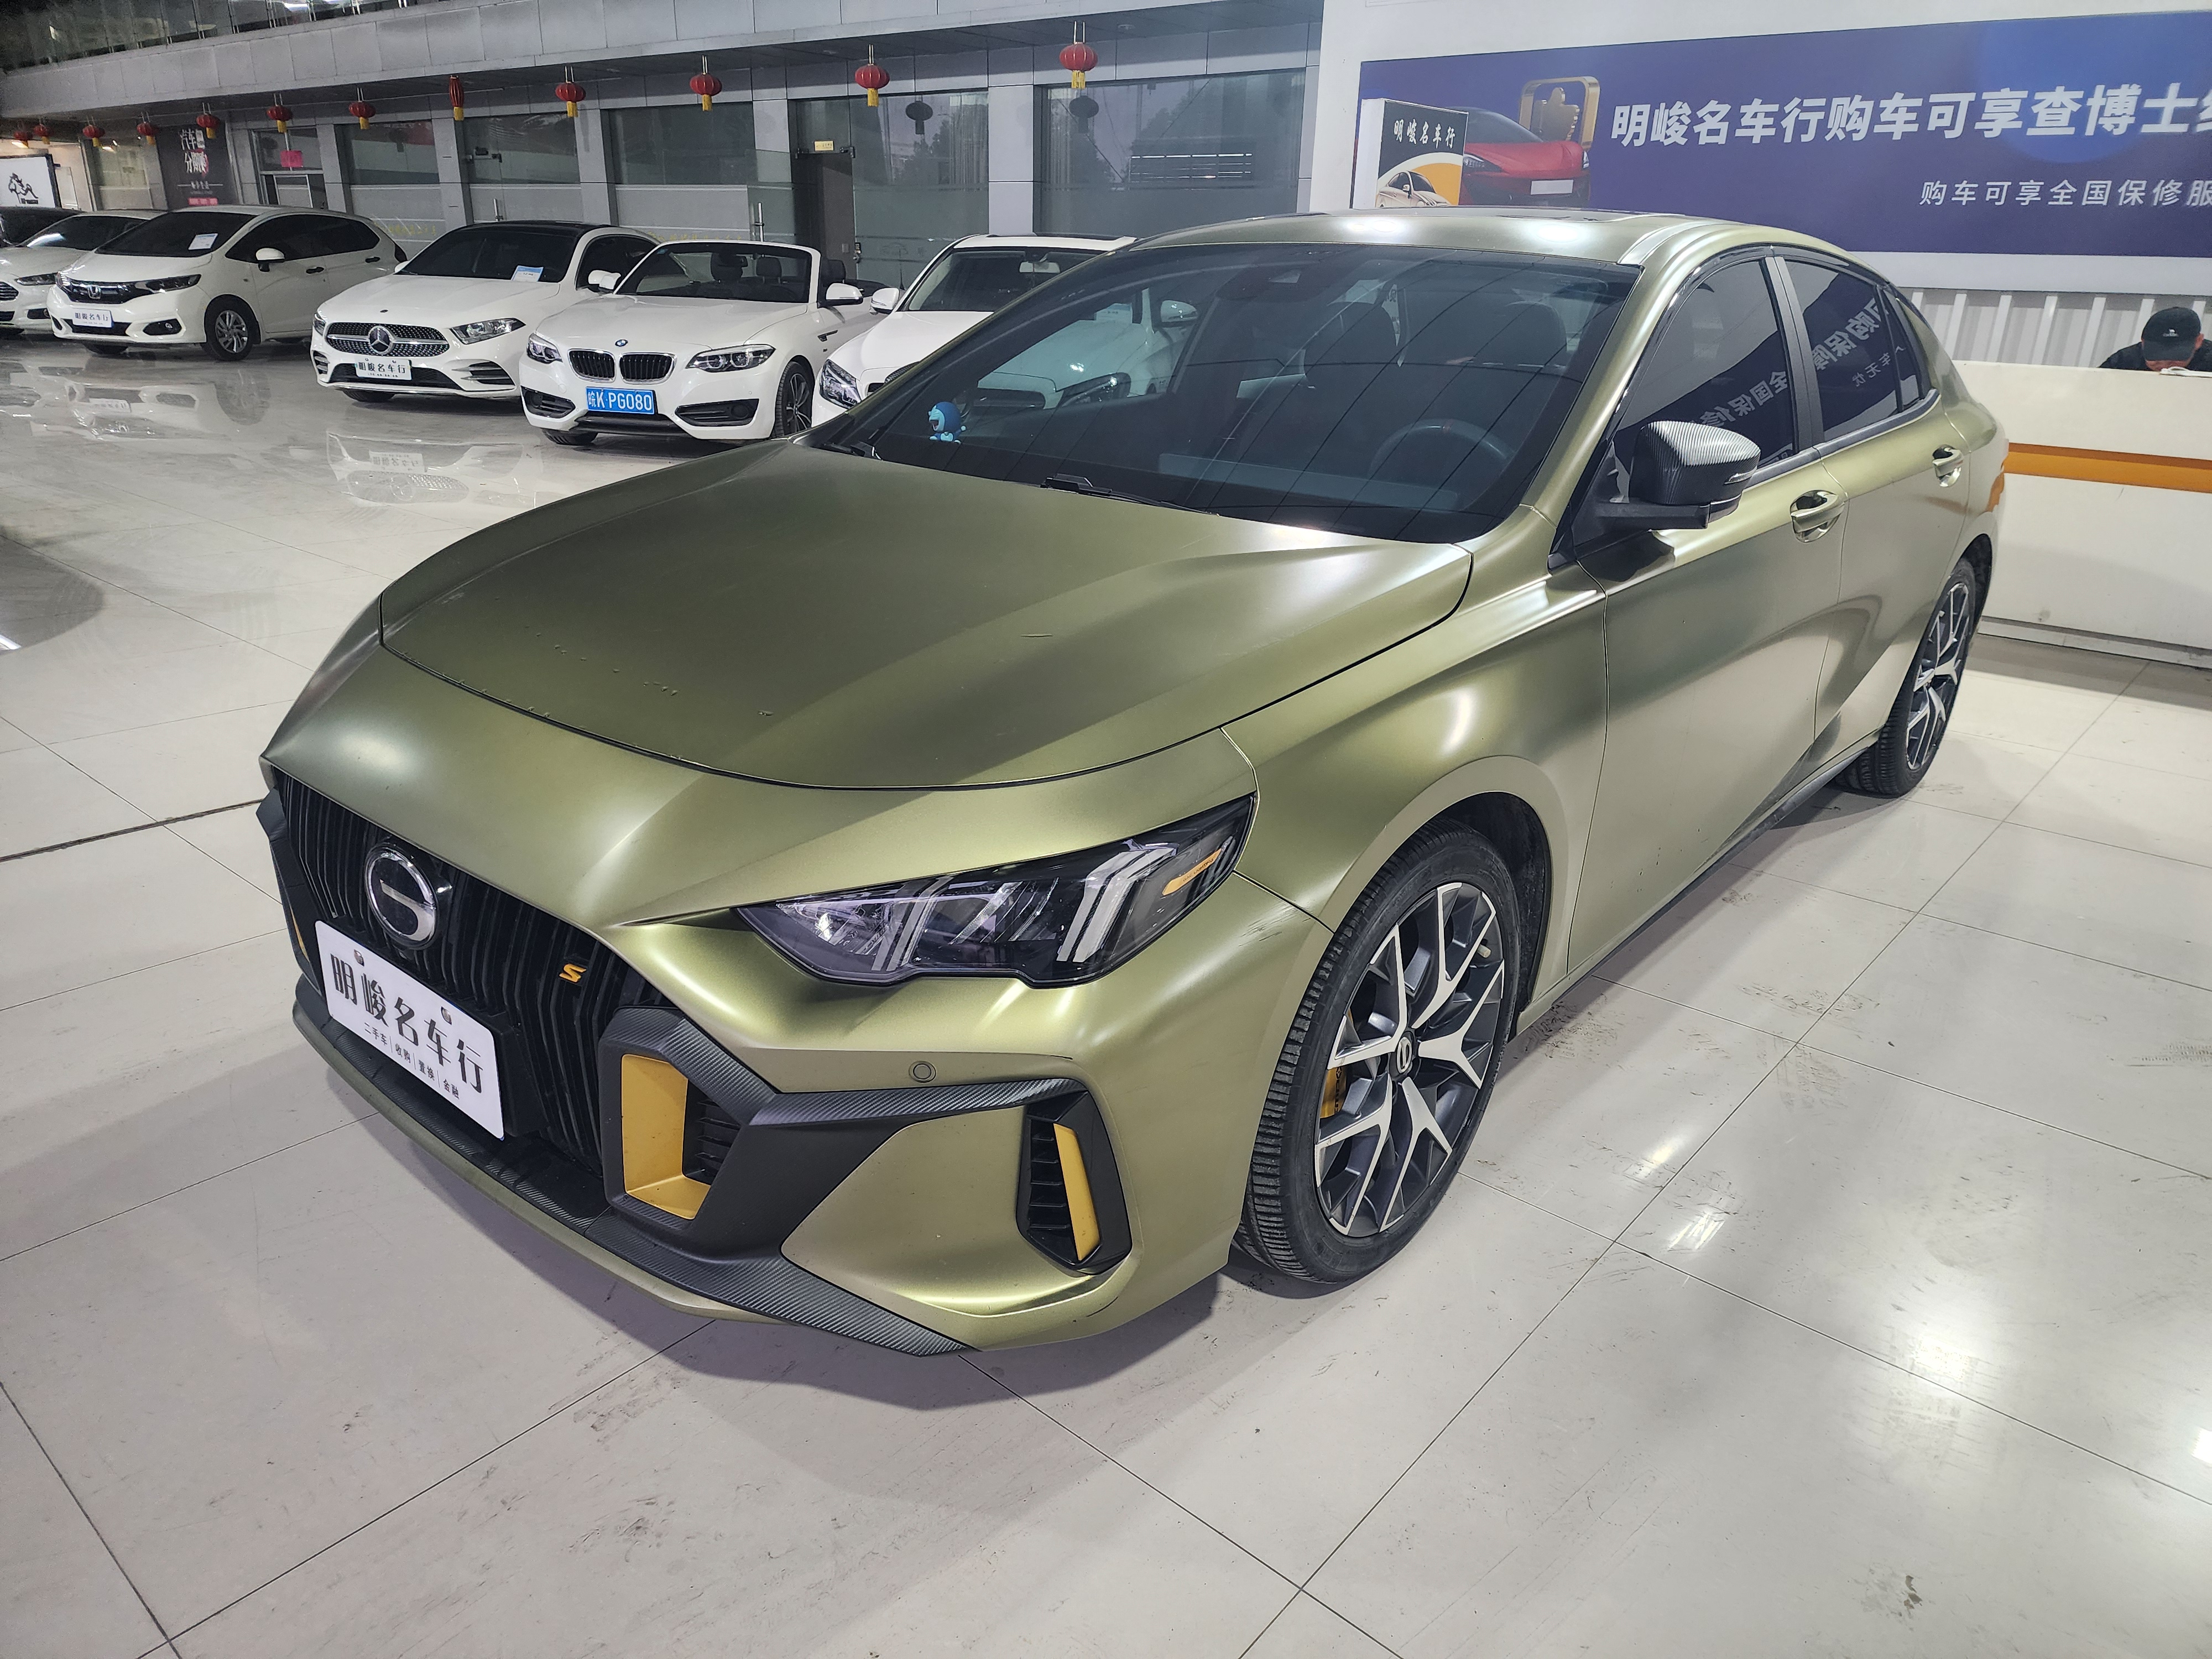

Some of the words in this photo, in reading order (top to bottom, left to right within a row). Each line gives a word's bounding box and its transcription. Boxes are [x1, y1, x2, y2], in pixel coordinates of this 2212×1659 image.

[1394, 118, 1455, 149] 明峻名车行
[1919, 179, 2212, 206] 购车可享全国保修服
[358, 362, 406, 373] 明峻名车行
[330, 953, 483, 1093] 明峻名车行
[364, 1022, 388, 1045] 二手车
